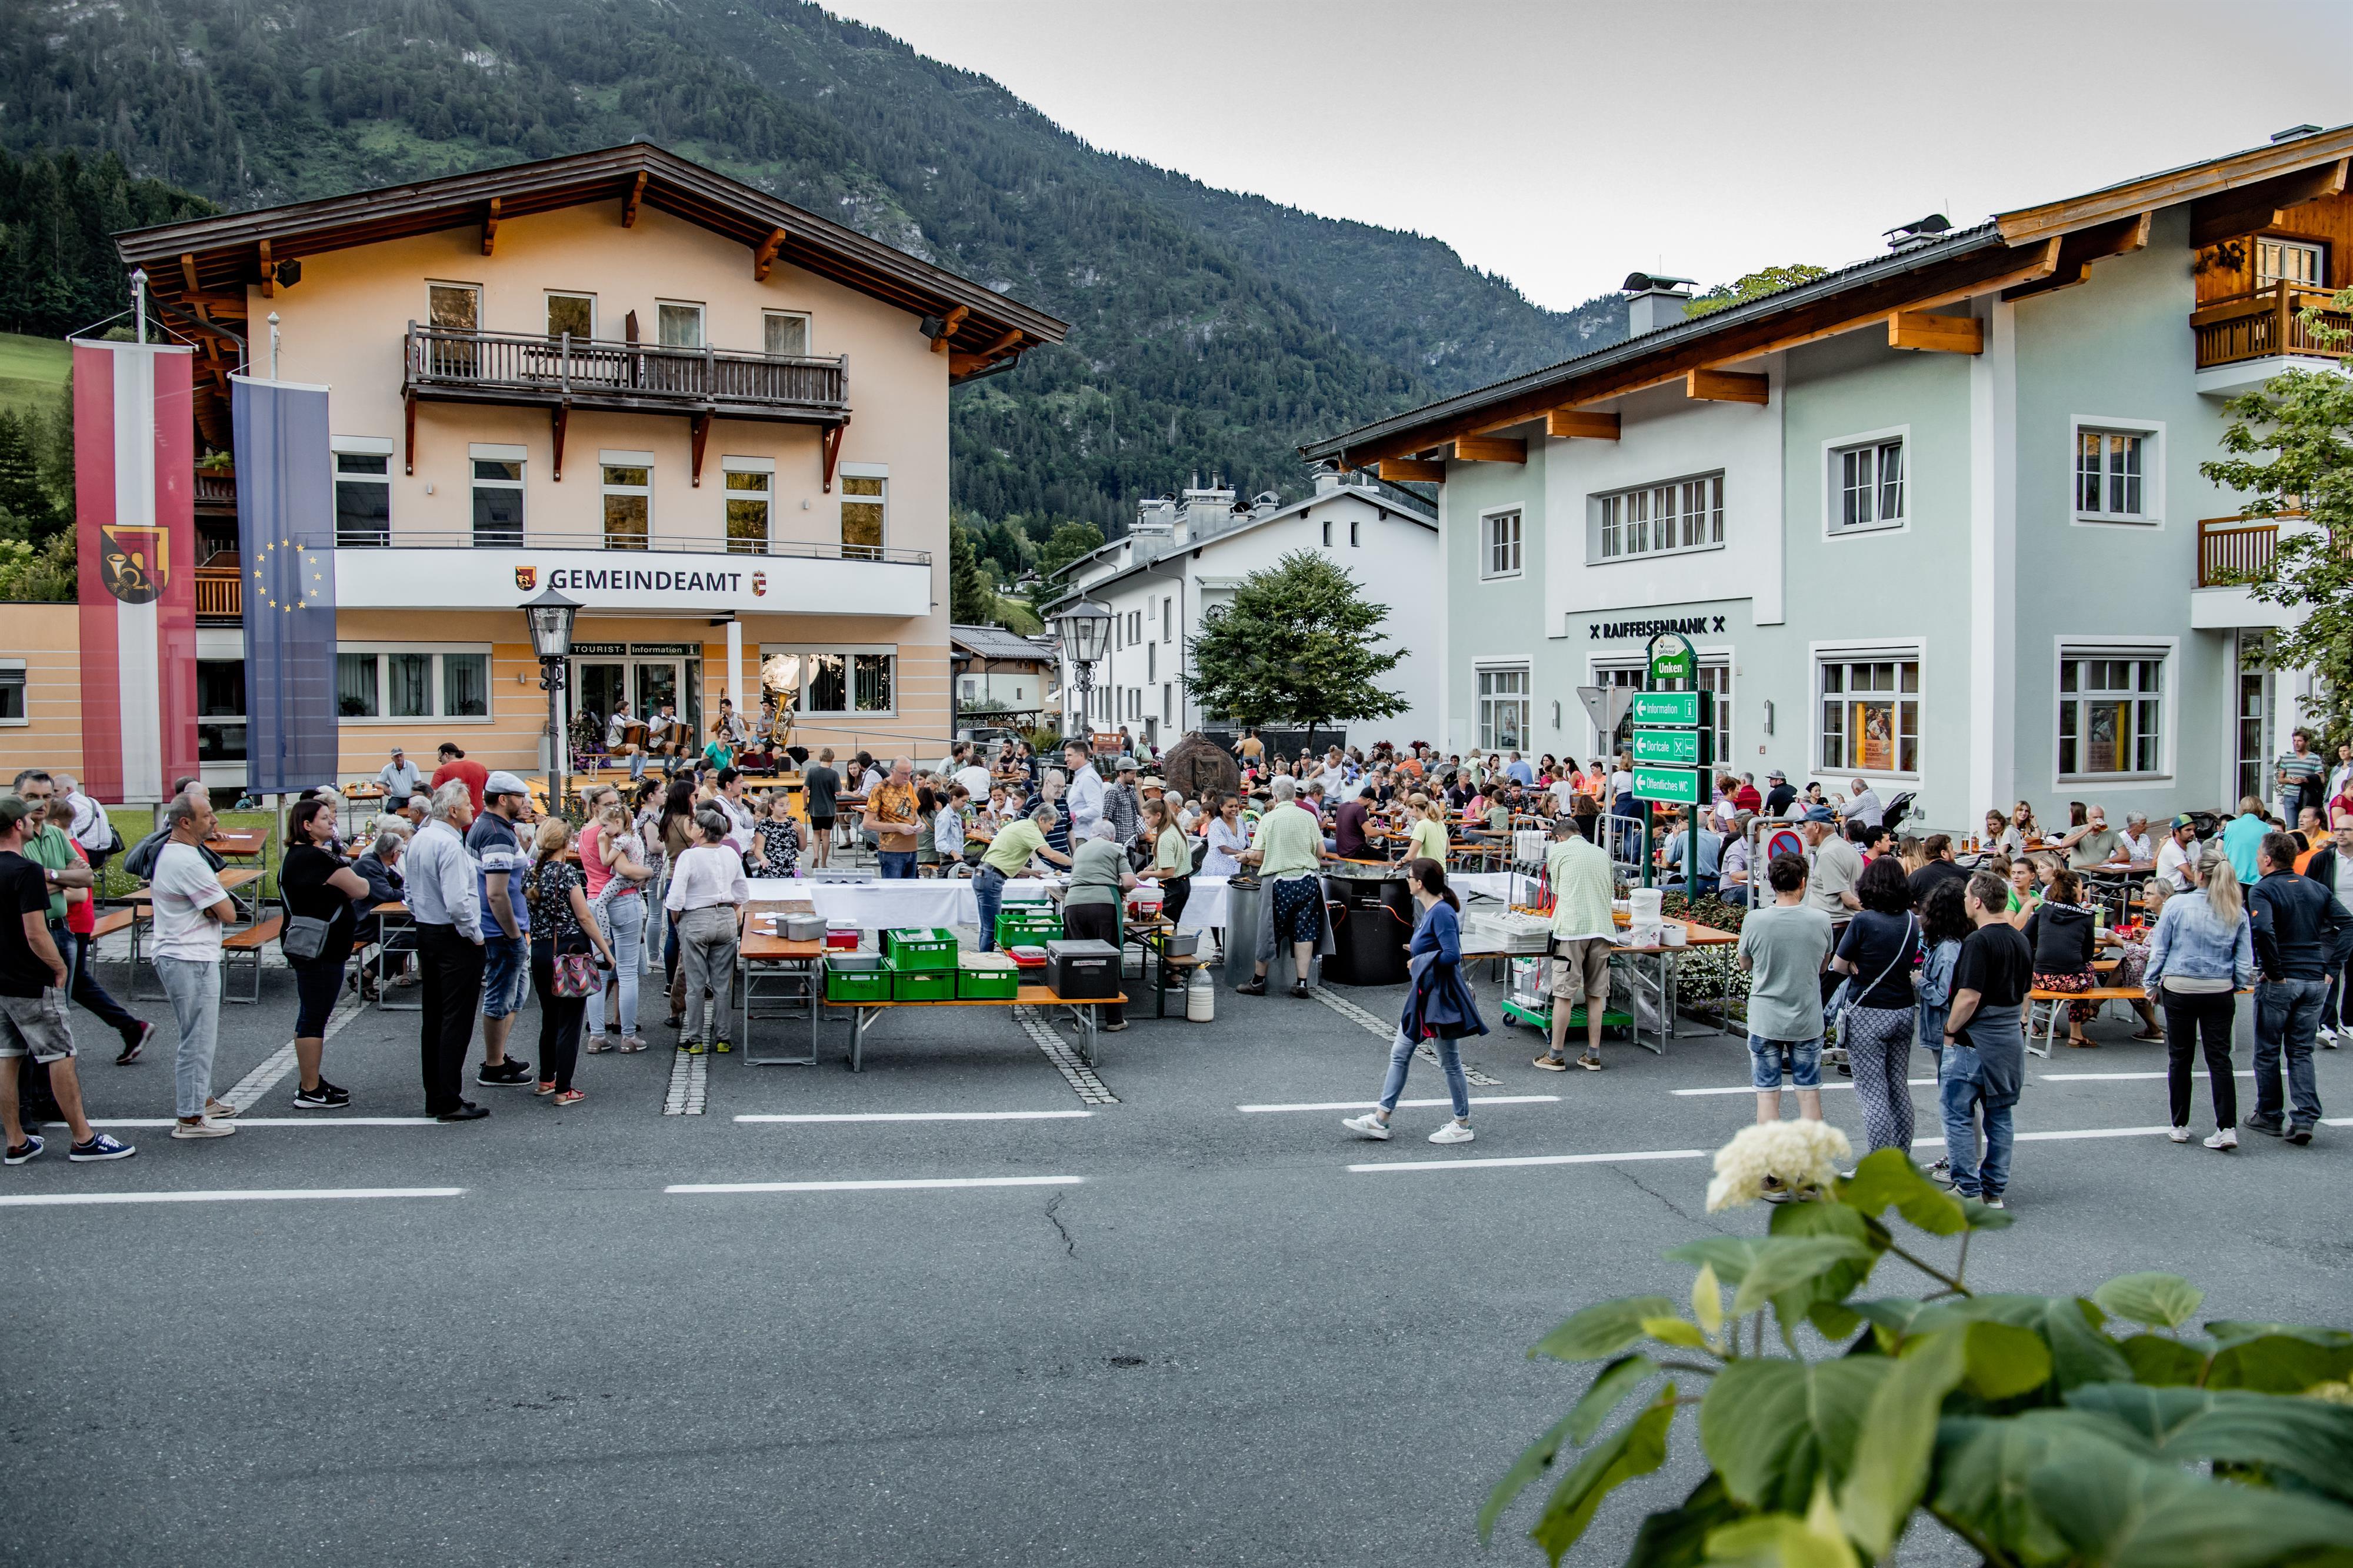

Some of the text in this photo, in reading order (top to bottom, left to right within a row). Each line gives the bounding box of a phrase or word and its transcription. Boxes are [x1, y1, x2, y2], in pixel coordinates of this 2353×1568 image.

[551, 569, 741, 592] GEMEINDEAMT
[1603, 618, 1708, 639] RAIFFEISENBANK
[1659, 662, 1682, 674] Unken
[1647, 703, 1678, 714] Information
[1647, 776, 1688, 792] Öffentliches WC
[2054, 902, 2093, 915] PERFORMANC
